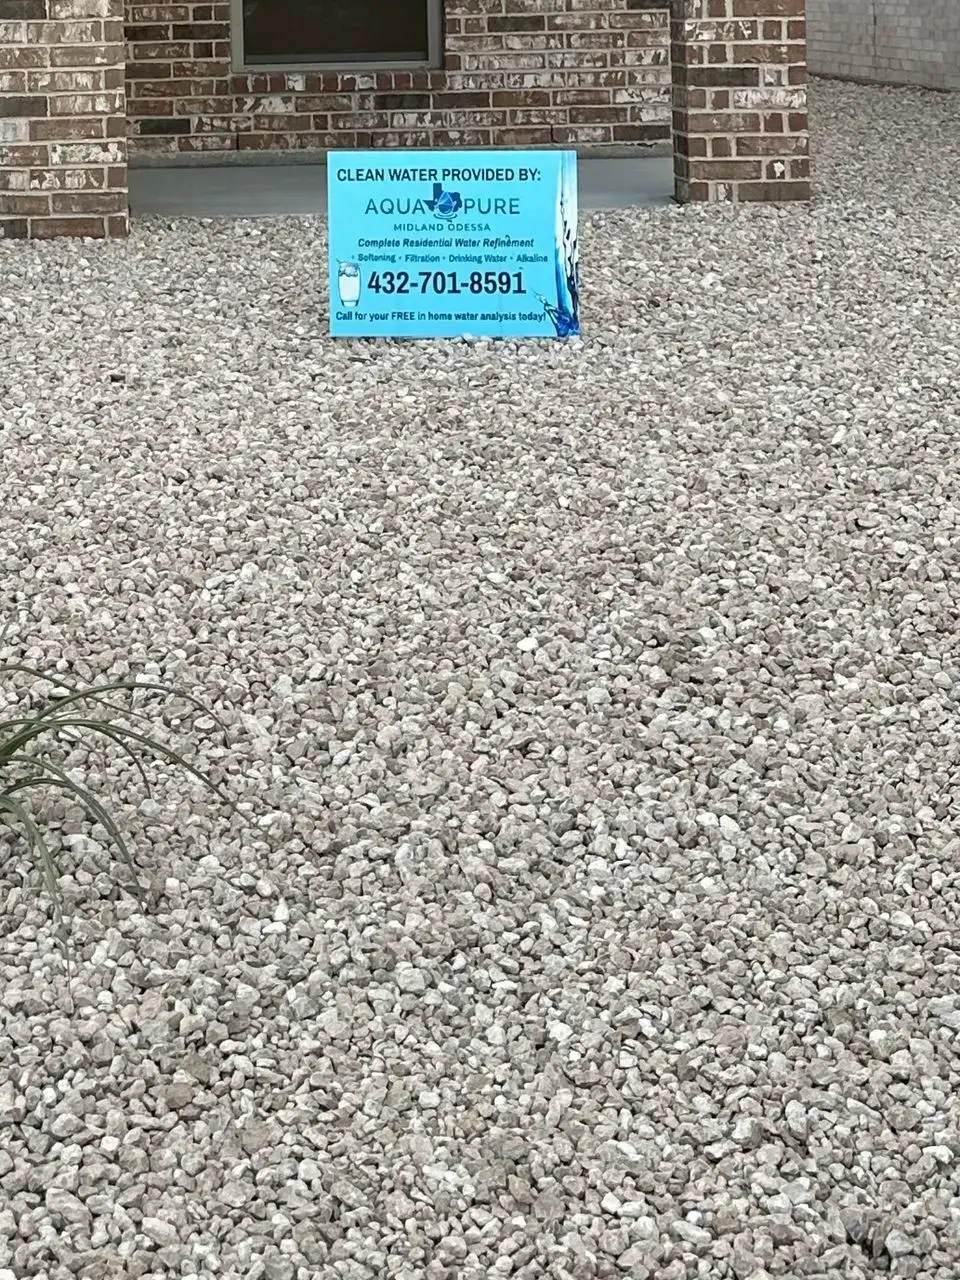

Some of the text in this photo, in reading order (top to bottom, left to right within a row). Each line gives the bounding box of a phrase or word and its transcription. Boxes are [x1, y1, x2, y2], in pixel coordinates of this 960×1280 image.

[337, 168, 541, 182] CLEAN WATER PROVIDED BY:
[365, 198, 520, 215] AQUA PURE
[393, 223, 491, 232] MIDLAND ODESSA
[358, 238, 534, 249] Complete Residential Water Refinement
[358, 254, 548, 264] Softening Filtration Drinking Water Alkaline
[367, 271, 526, 294] 432-701-8591
[336, 312, 546, 322] Call for your FREE in home water analysis today!
